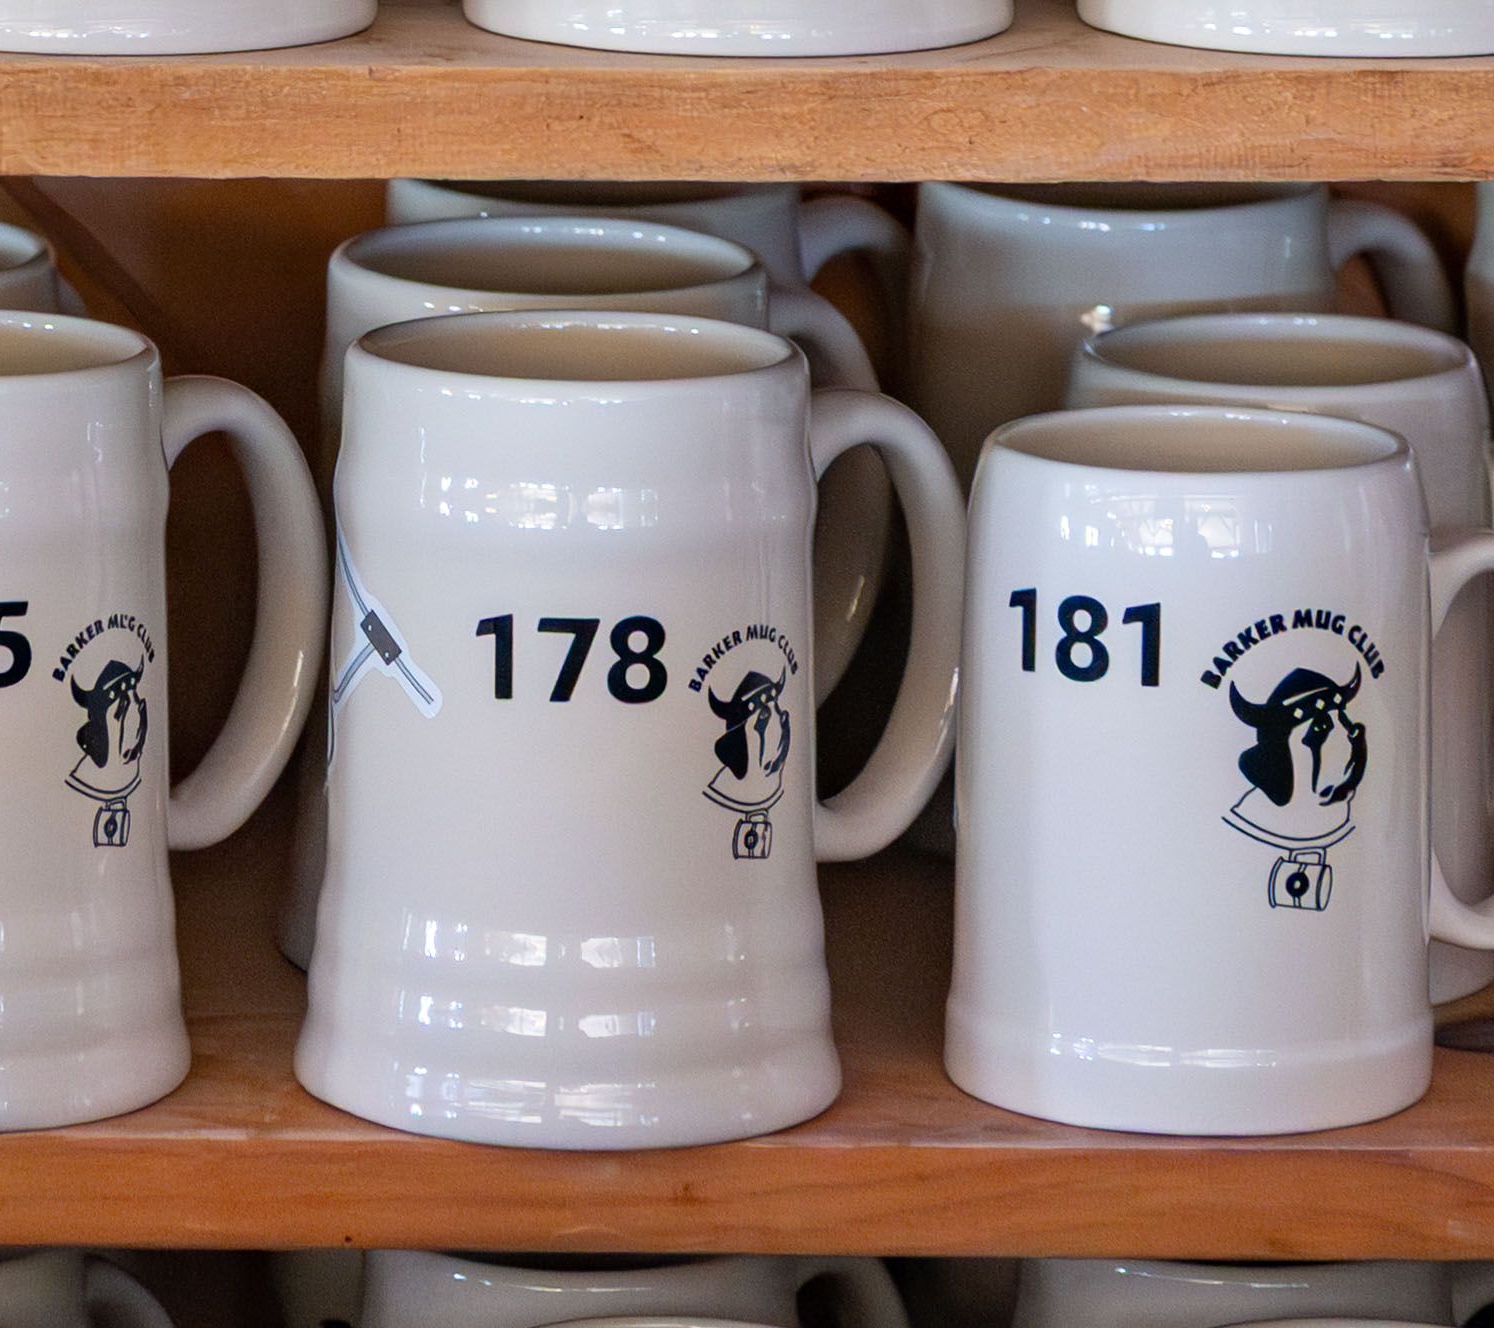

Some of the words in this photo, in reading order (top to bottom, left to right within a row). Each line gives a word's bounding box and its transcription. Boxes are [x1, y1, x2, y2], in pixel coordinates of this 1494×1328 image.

[476, 613, 668, 704] 178
[688, 629, 743, 694] BARKER
[745, 625, 777, 649] MUG
[776, 634, 799, 676] CLUB
[1009, 588, 1161, 688] 181
[1201, 612, 1287, 691] BARKER
[1292, 608, 1345, 633] MUG
[1347, 624, 1386, 680] CLUB
